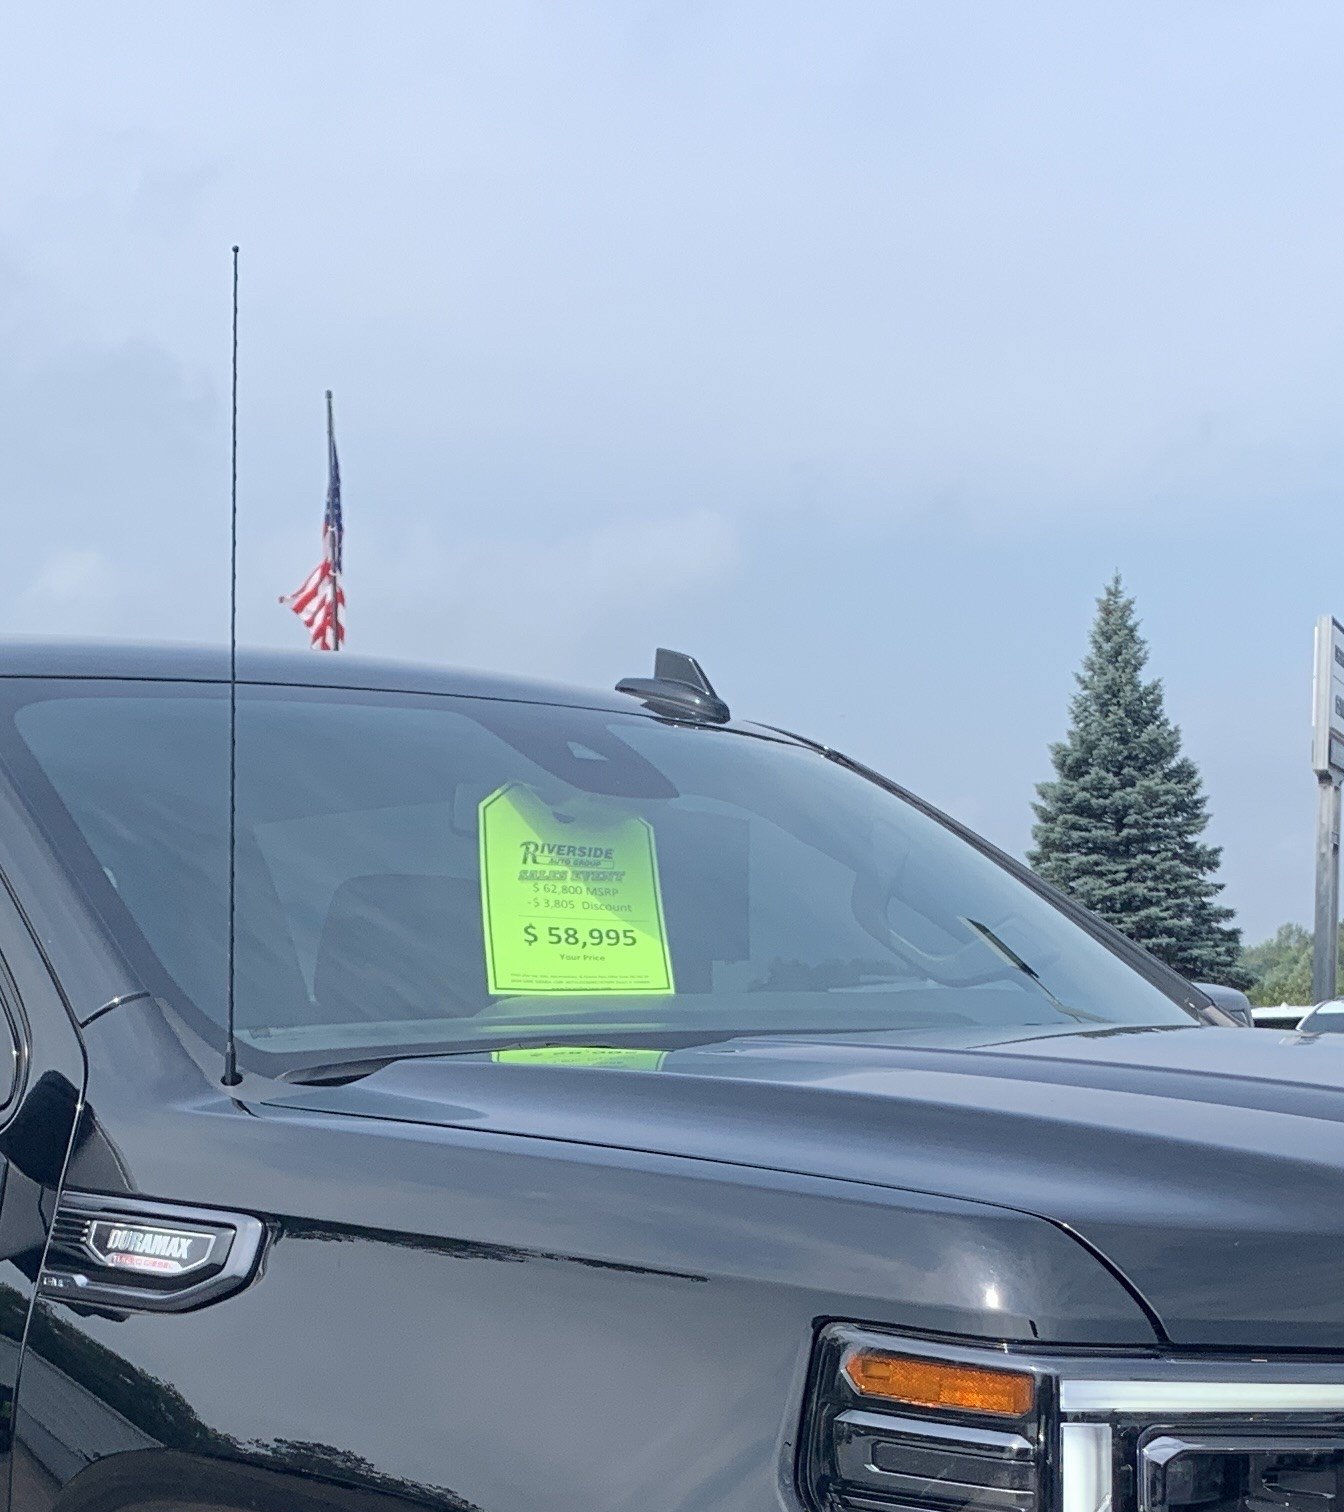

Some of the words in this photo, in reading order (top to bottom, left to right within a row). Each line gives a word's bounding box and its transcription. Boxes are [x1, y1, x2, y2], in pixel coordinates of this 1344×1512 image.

[519, 841, 614, 865] RIVERSIDE
[549, 858, 571, 866] AUTO
[573, 859, 601, 867] GROUP
[518, 869, 569, 881] SALES
[571, 870, 626, 882] EVENT
[543, 884, 583, 896] 62,800
[586, 887, 619, 896] MSRP
[544, 898, 576, 910] 3,805
[582, 901, 633, 912] Discount
[523, 923, 539, 947] $
[547, 926, 638, 949] 58,995
[559, 953, 581, 961] Your
[106, 1228, 194, 1260] DURAMAX
